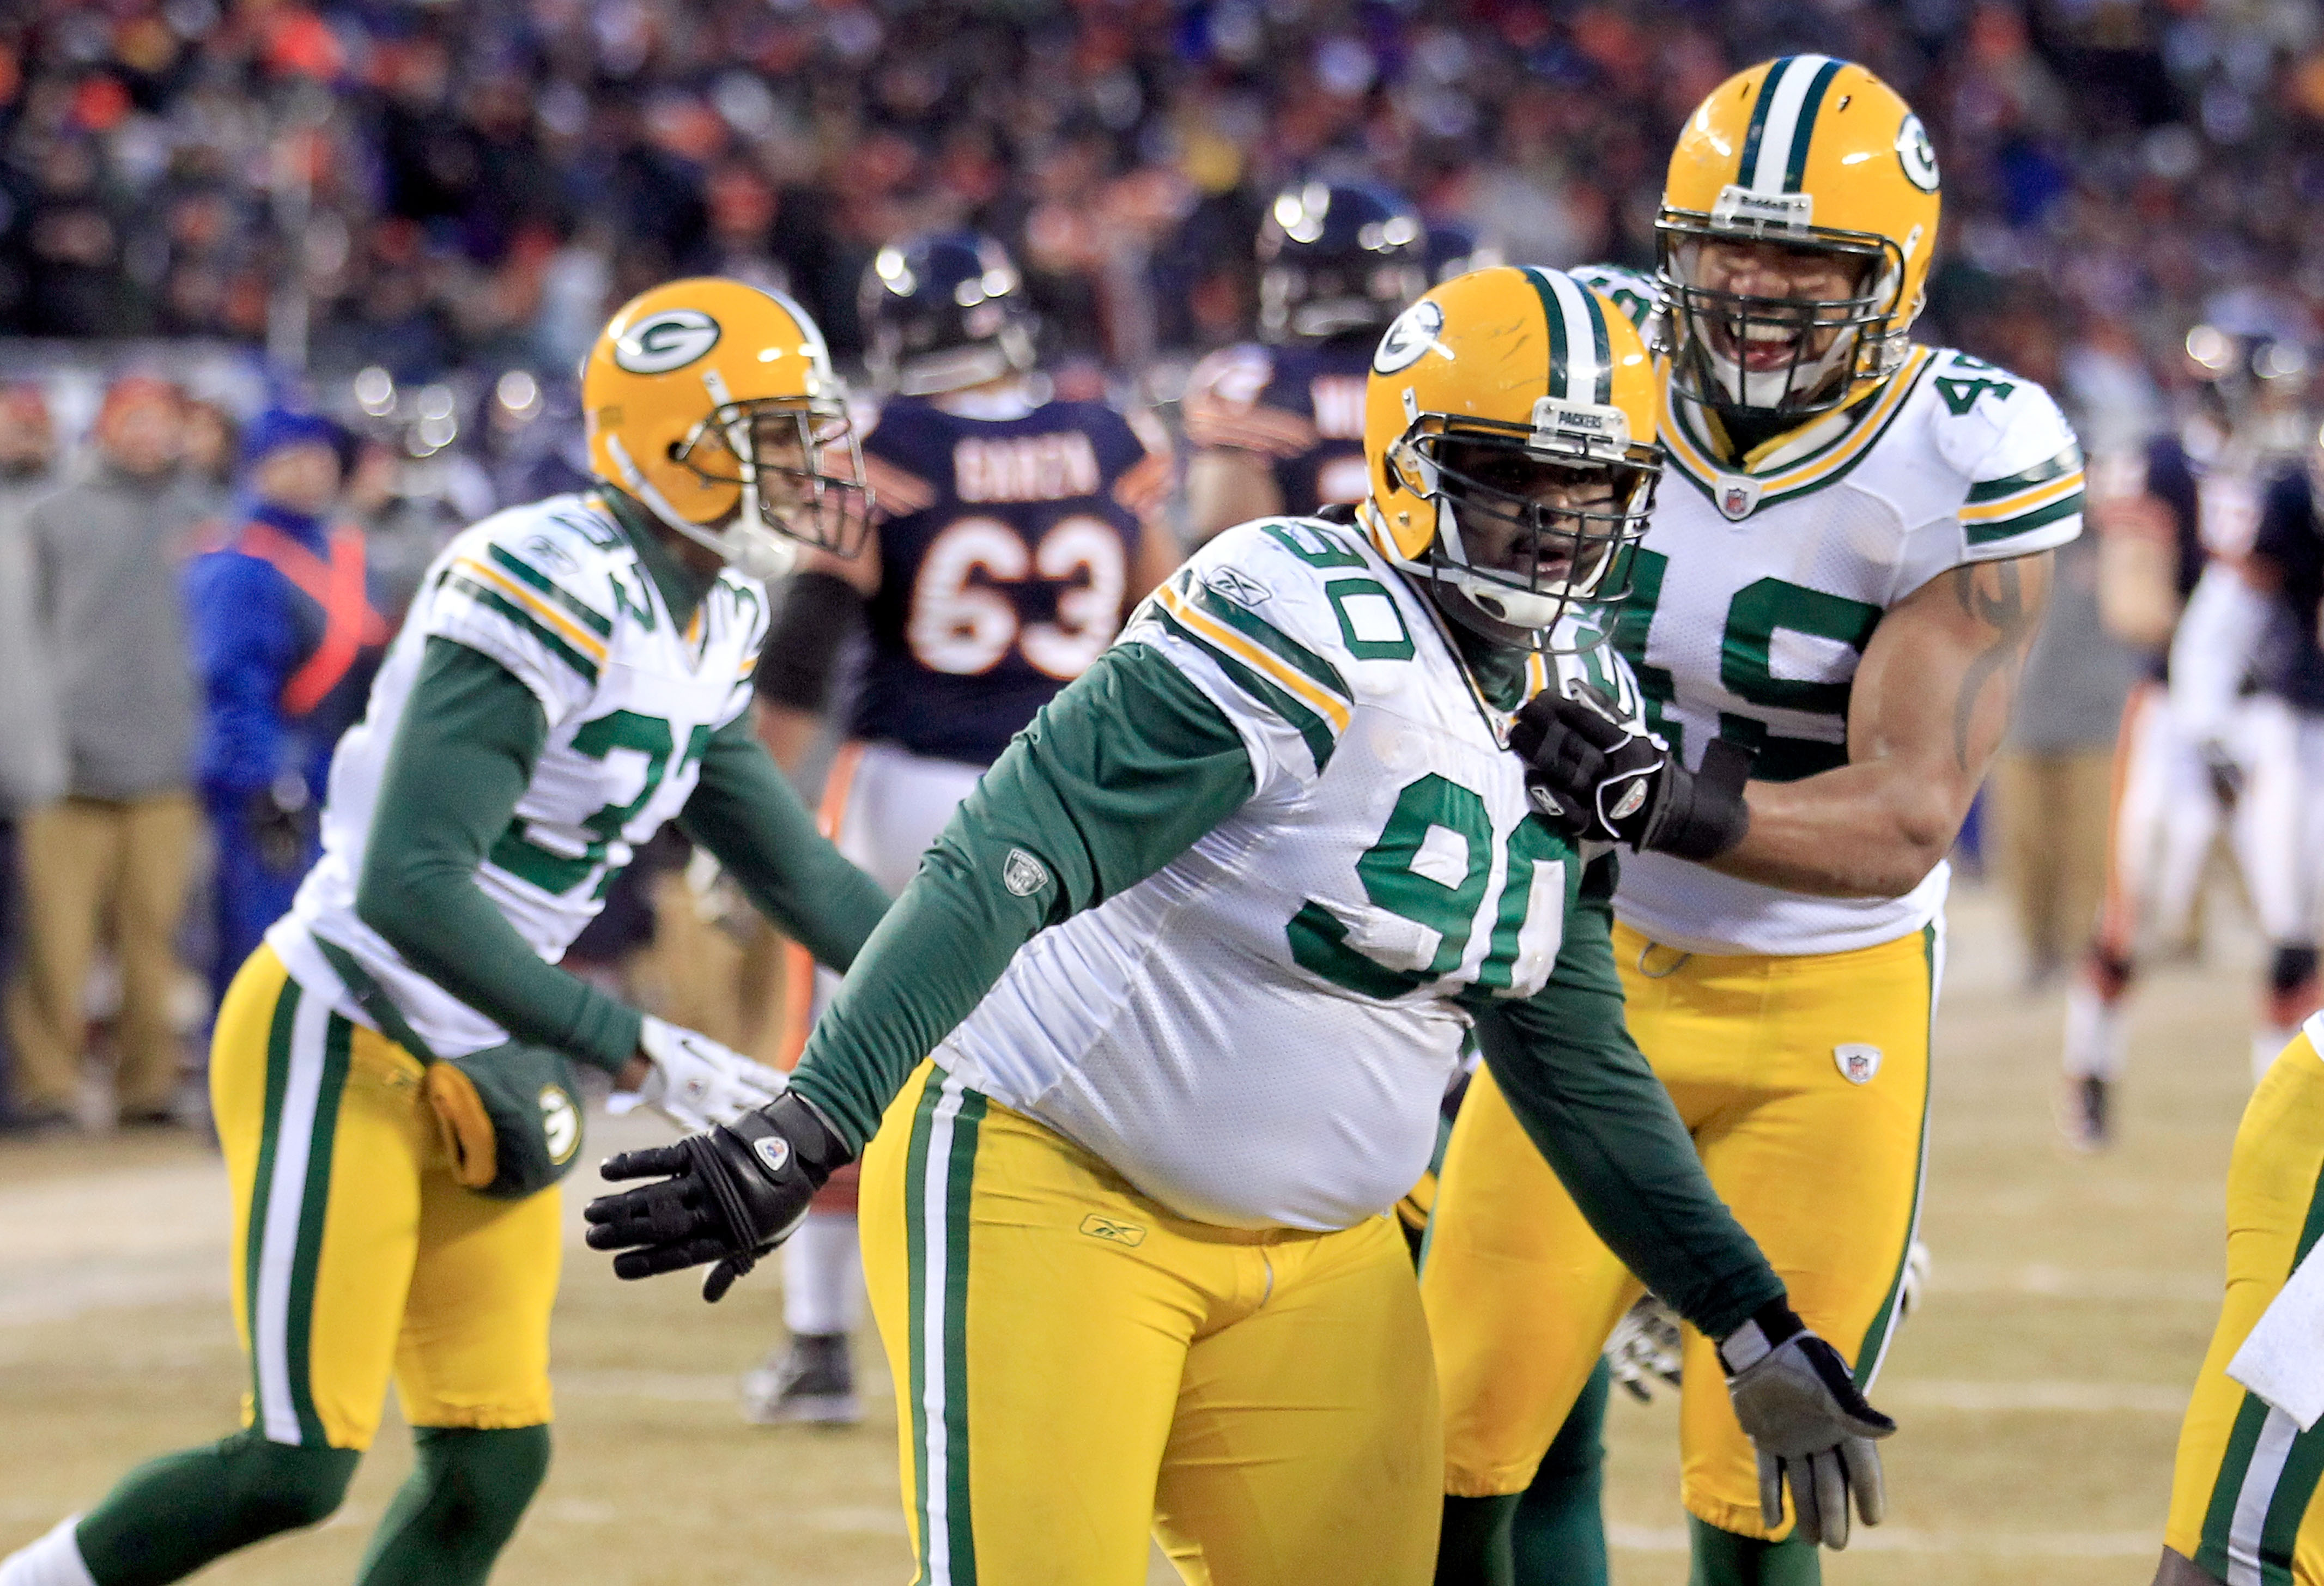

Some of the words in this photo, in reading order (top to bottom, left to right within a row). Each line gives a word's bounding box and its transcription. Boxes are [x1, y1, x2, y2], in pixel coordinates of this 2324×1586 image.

[616, 308, 721, 374] G
[1559, 411, 1601, 429] PACKERS
[906, 514, 1126, 681] 63
[1260, 521, 1415, 661] 90
[1286, 771, 1582, 1000] 90
